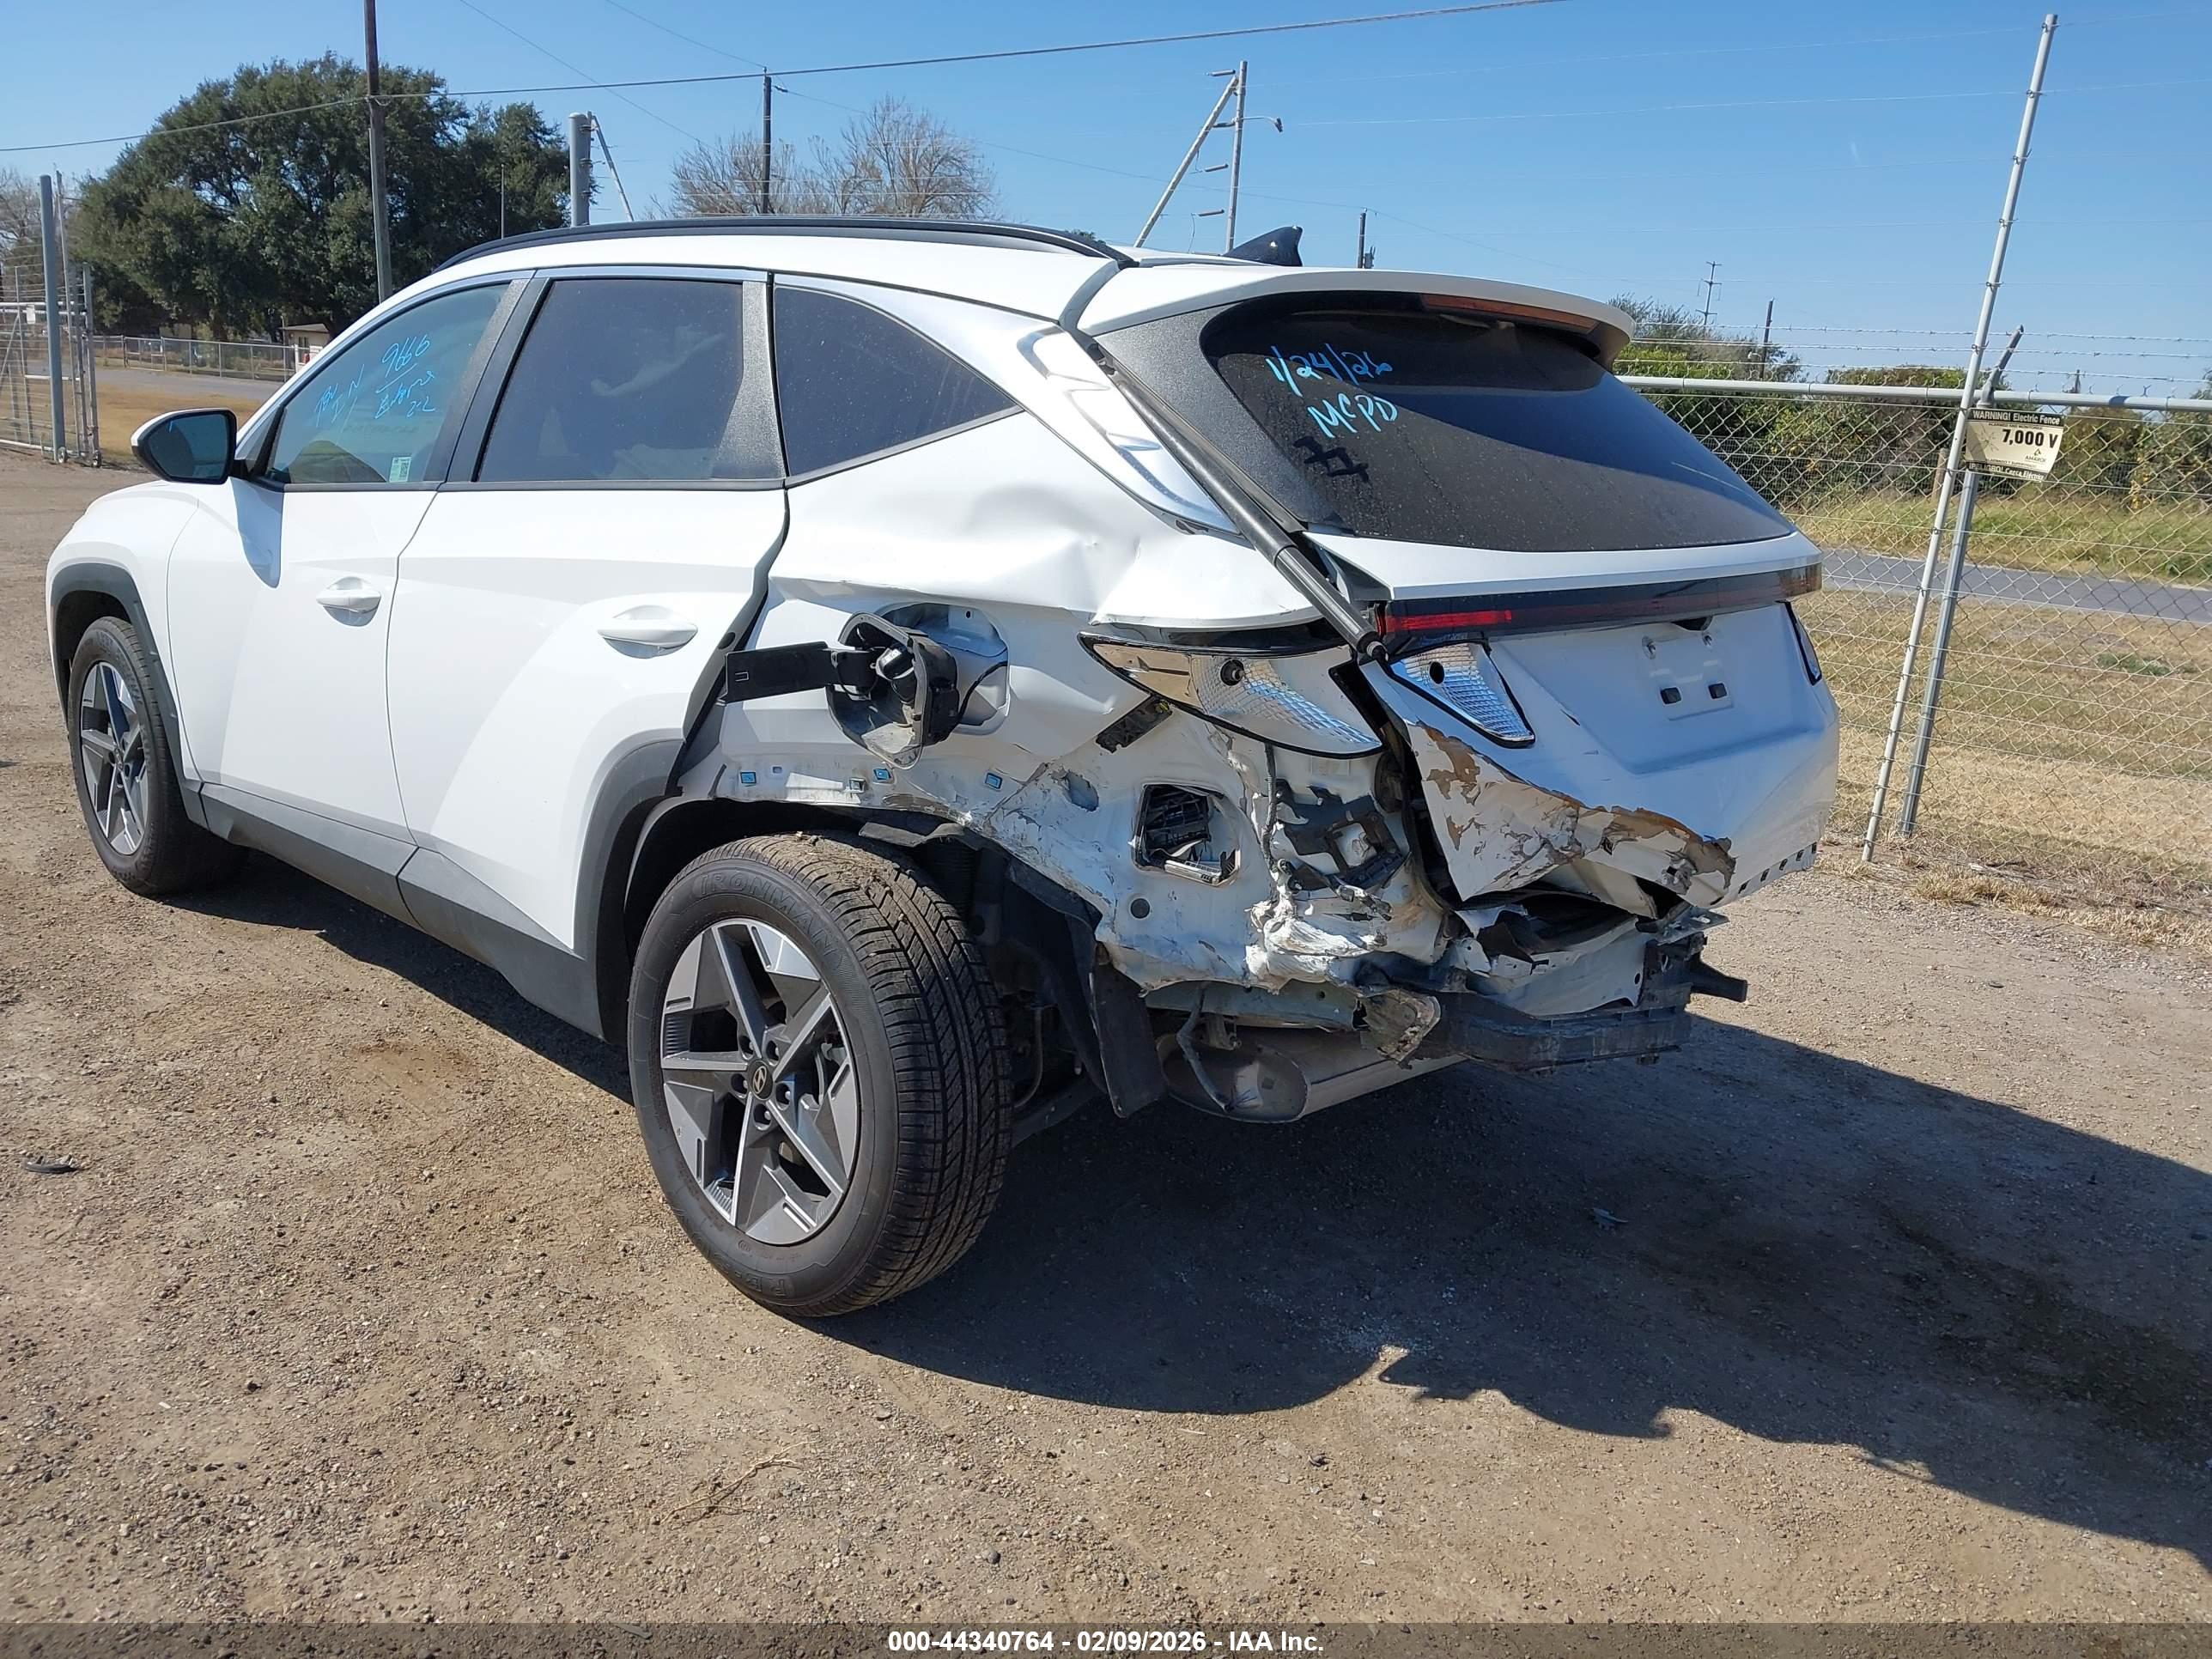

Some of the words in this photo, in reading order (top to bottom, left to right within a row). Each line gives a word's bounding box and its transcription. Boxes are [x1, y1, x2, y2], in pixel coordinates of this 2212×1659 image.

[1265, 343, 1393, 398] 1/24/26
[1973, 410, 2011, 421] WARNING!
[2013, 413, 2039, 422] Electric
[2039, 415, 2060, 425] Fence
[2002, 428, 2045, 447] 7,000
[2049, 433, 2058, 448] V
[699, 872, 838, 957] IRONMAN
